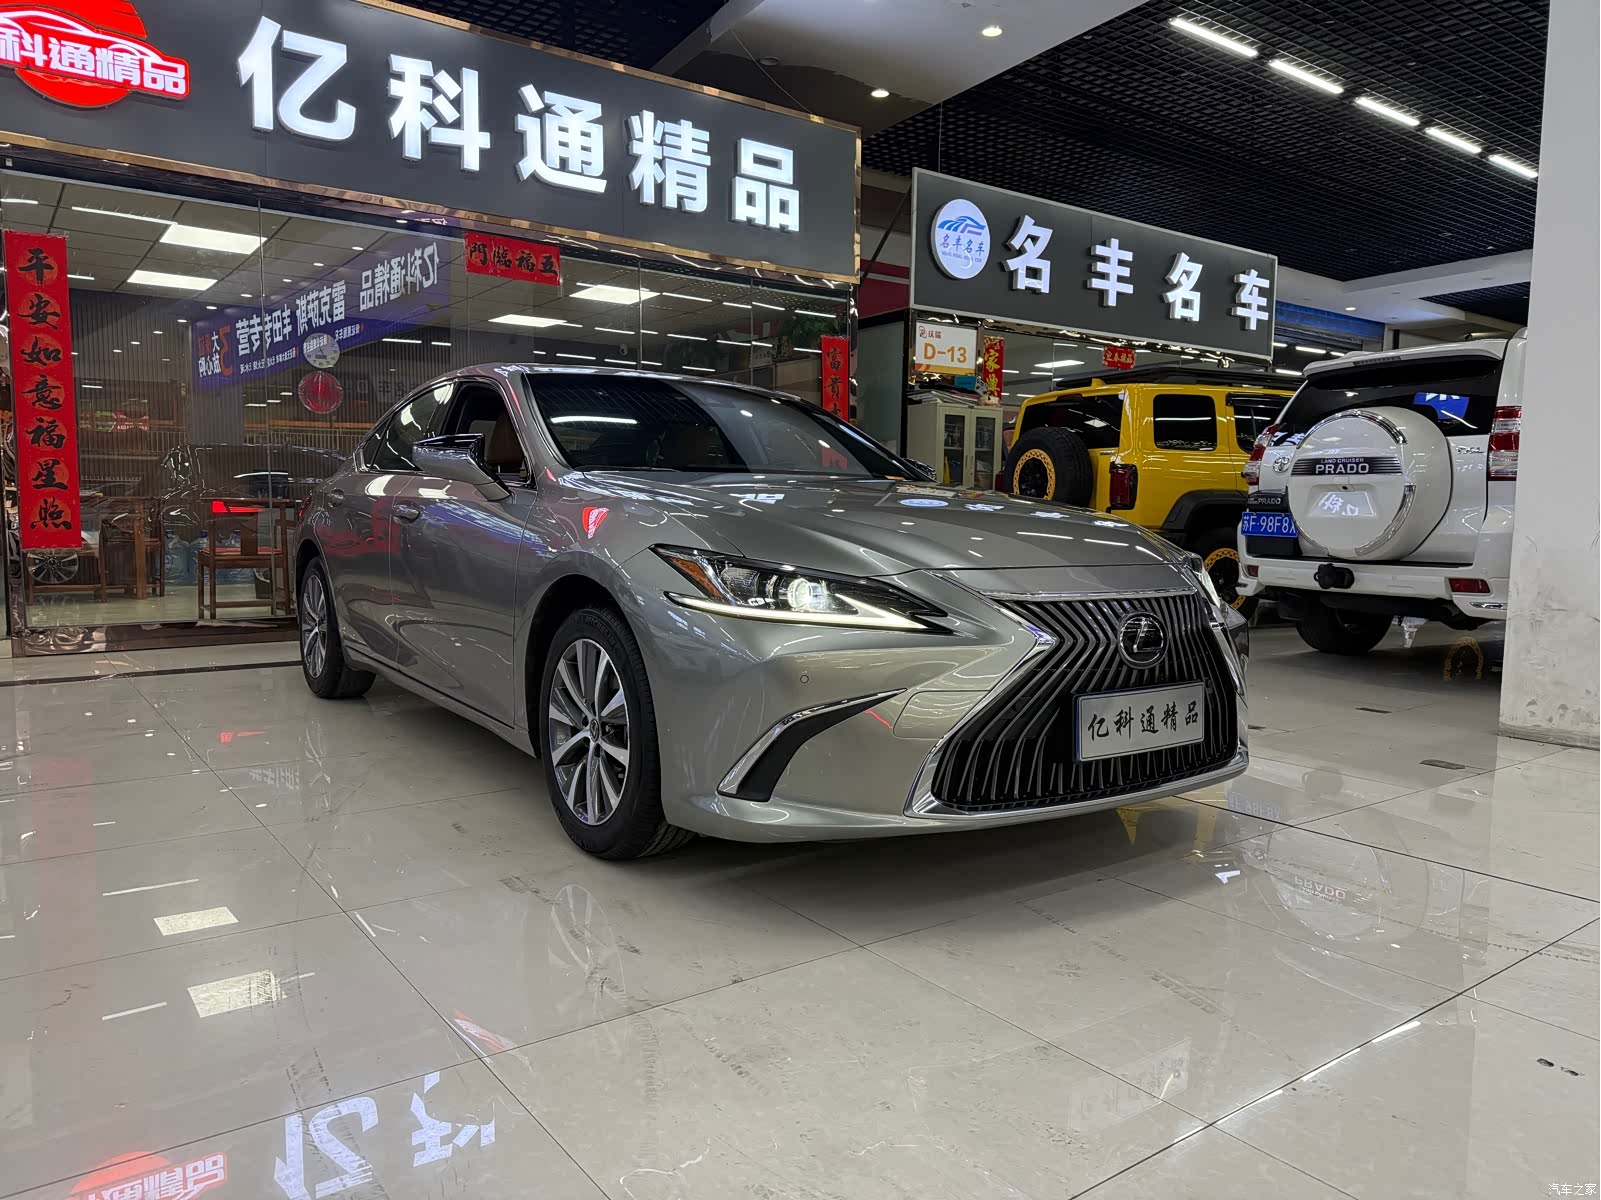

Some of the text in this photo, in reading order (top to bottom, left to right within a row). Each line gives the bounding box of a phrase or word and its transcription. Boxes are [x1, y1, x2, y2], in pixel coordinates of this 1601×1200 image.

[237, 15, 801, 233] 亿科通精品
[940, 233, 985, 257] 名丰名车
[1002, 214, 1271, 331] 名丰名车
[923, 343, 968, 364] D-13
[17, 247, 73, 530] 平安如意福星照
[1315, 463, 1369, 475] PRADO
[1257, 497, 1282, 505] PRADO
[1087, 700, 1199, 741] 亿科通精品
